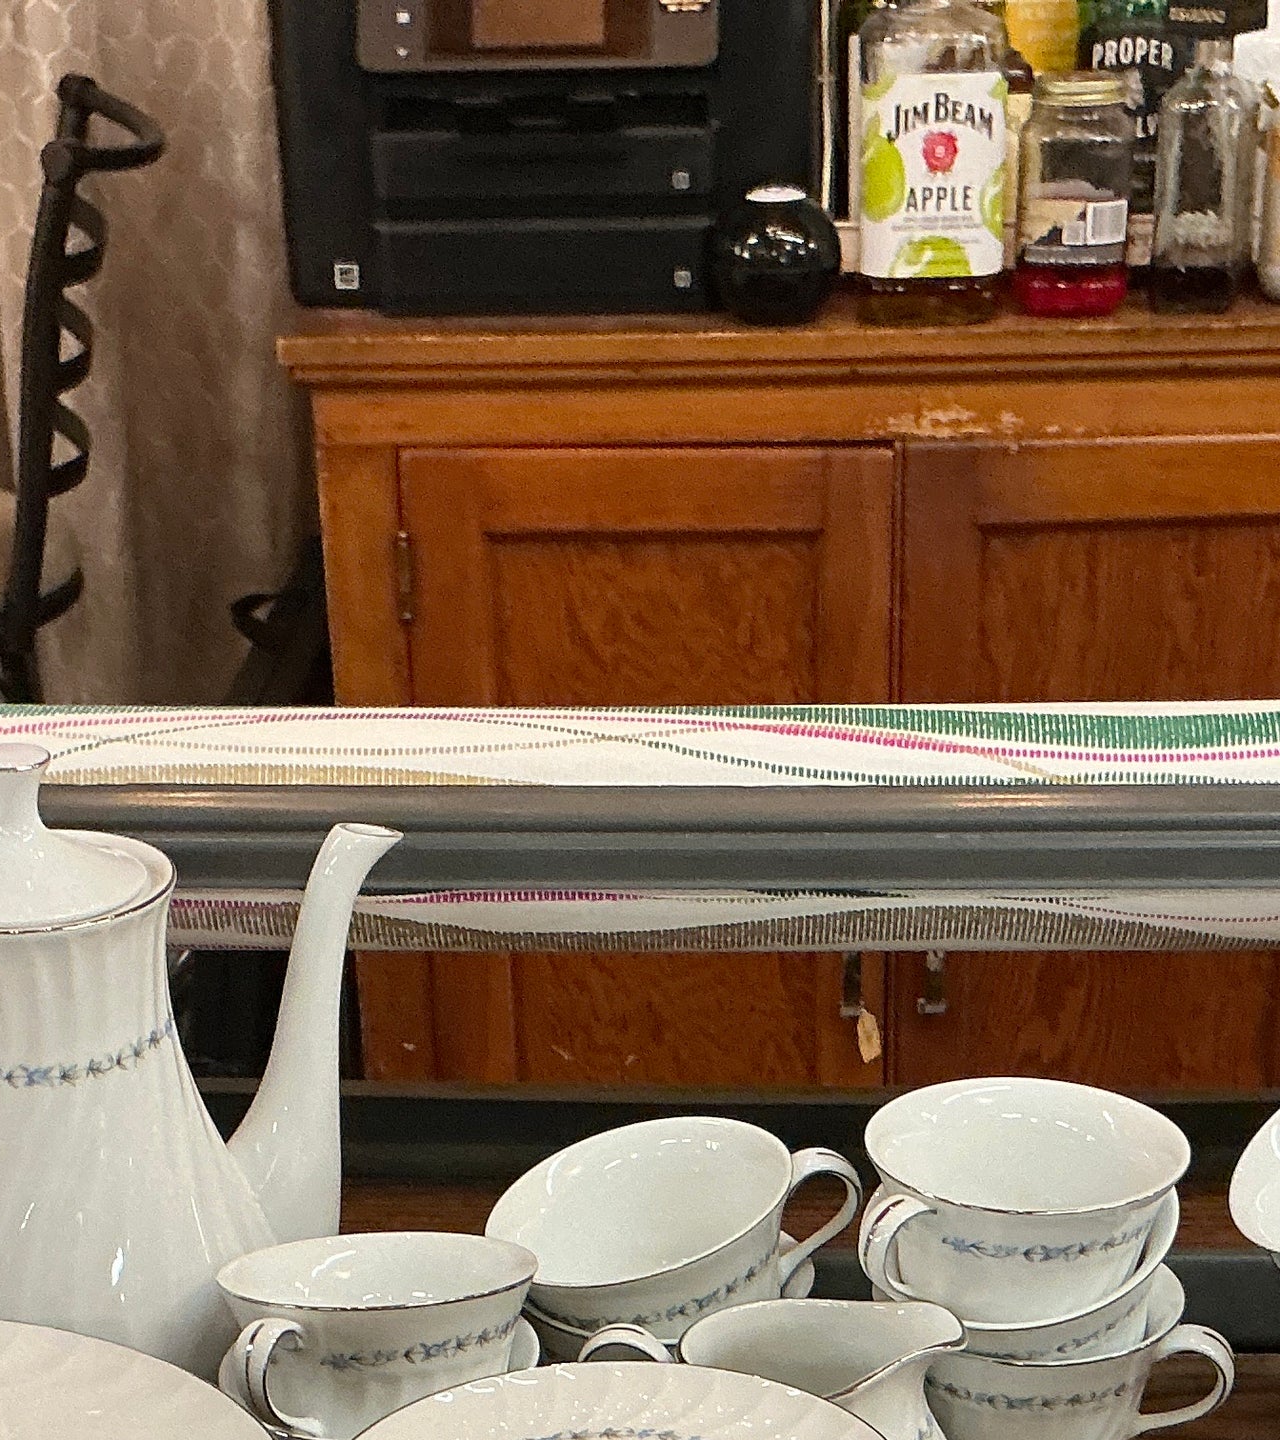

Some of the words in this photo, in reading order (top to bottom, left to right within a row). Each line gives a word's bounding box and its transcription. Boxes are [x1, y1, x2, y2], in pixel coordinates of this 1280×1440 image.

[1092, 37, 1173, 71] PROPER
[886, 101, 929, 144] JIM
[933, 92, 993, 141] BEAM
[905, 186, 973, 212] APPLE
